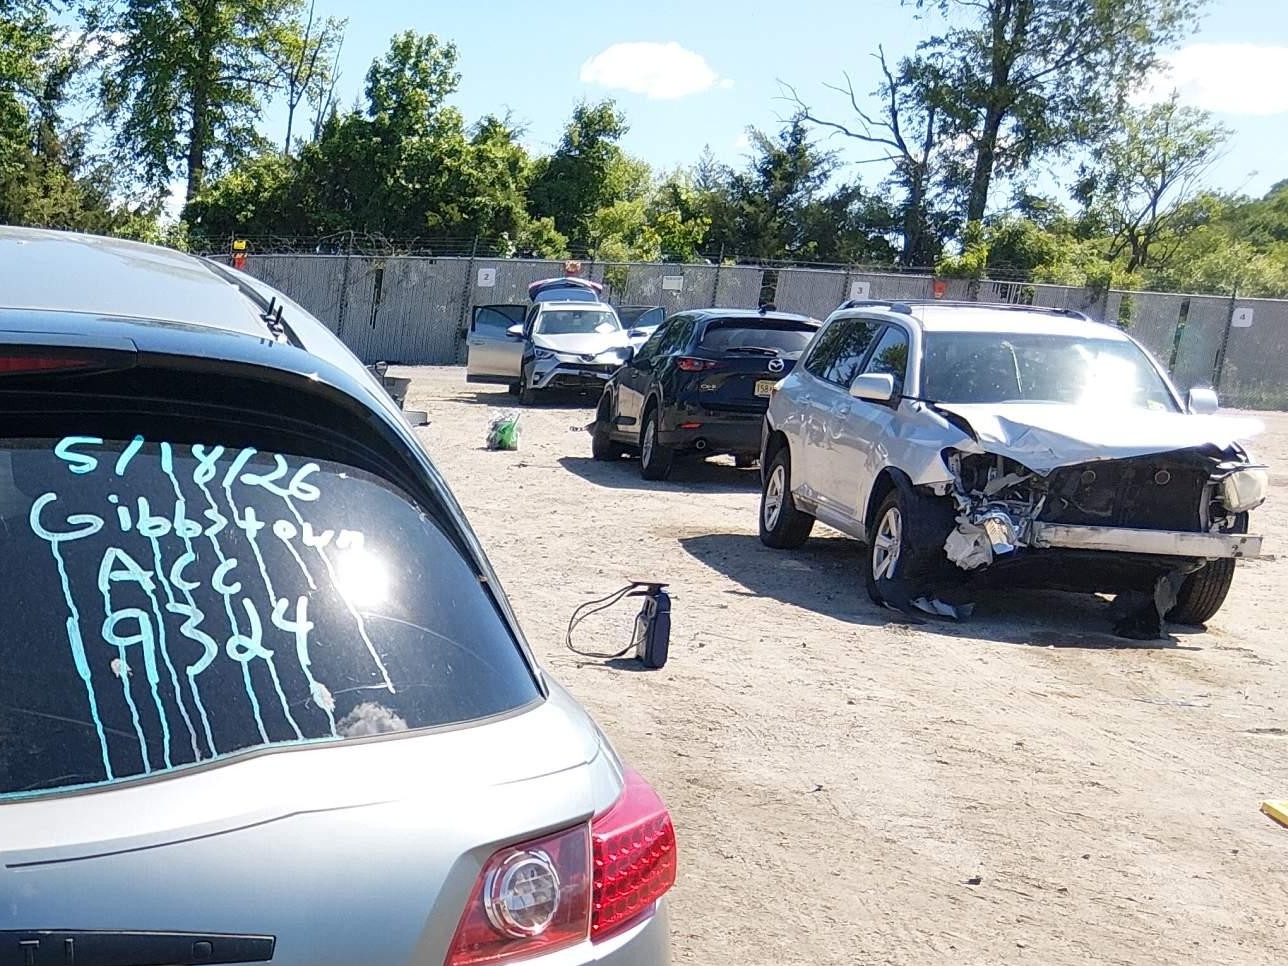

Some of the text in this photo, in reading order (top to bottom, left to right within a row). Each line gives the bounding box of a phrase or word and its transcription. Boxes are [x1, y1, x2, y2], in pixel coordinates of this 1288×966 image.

[483, 273, 490, 281] 2
[856, 287, 863, 295] 3
[54, 435, 322, 501] 5/18/26
